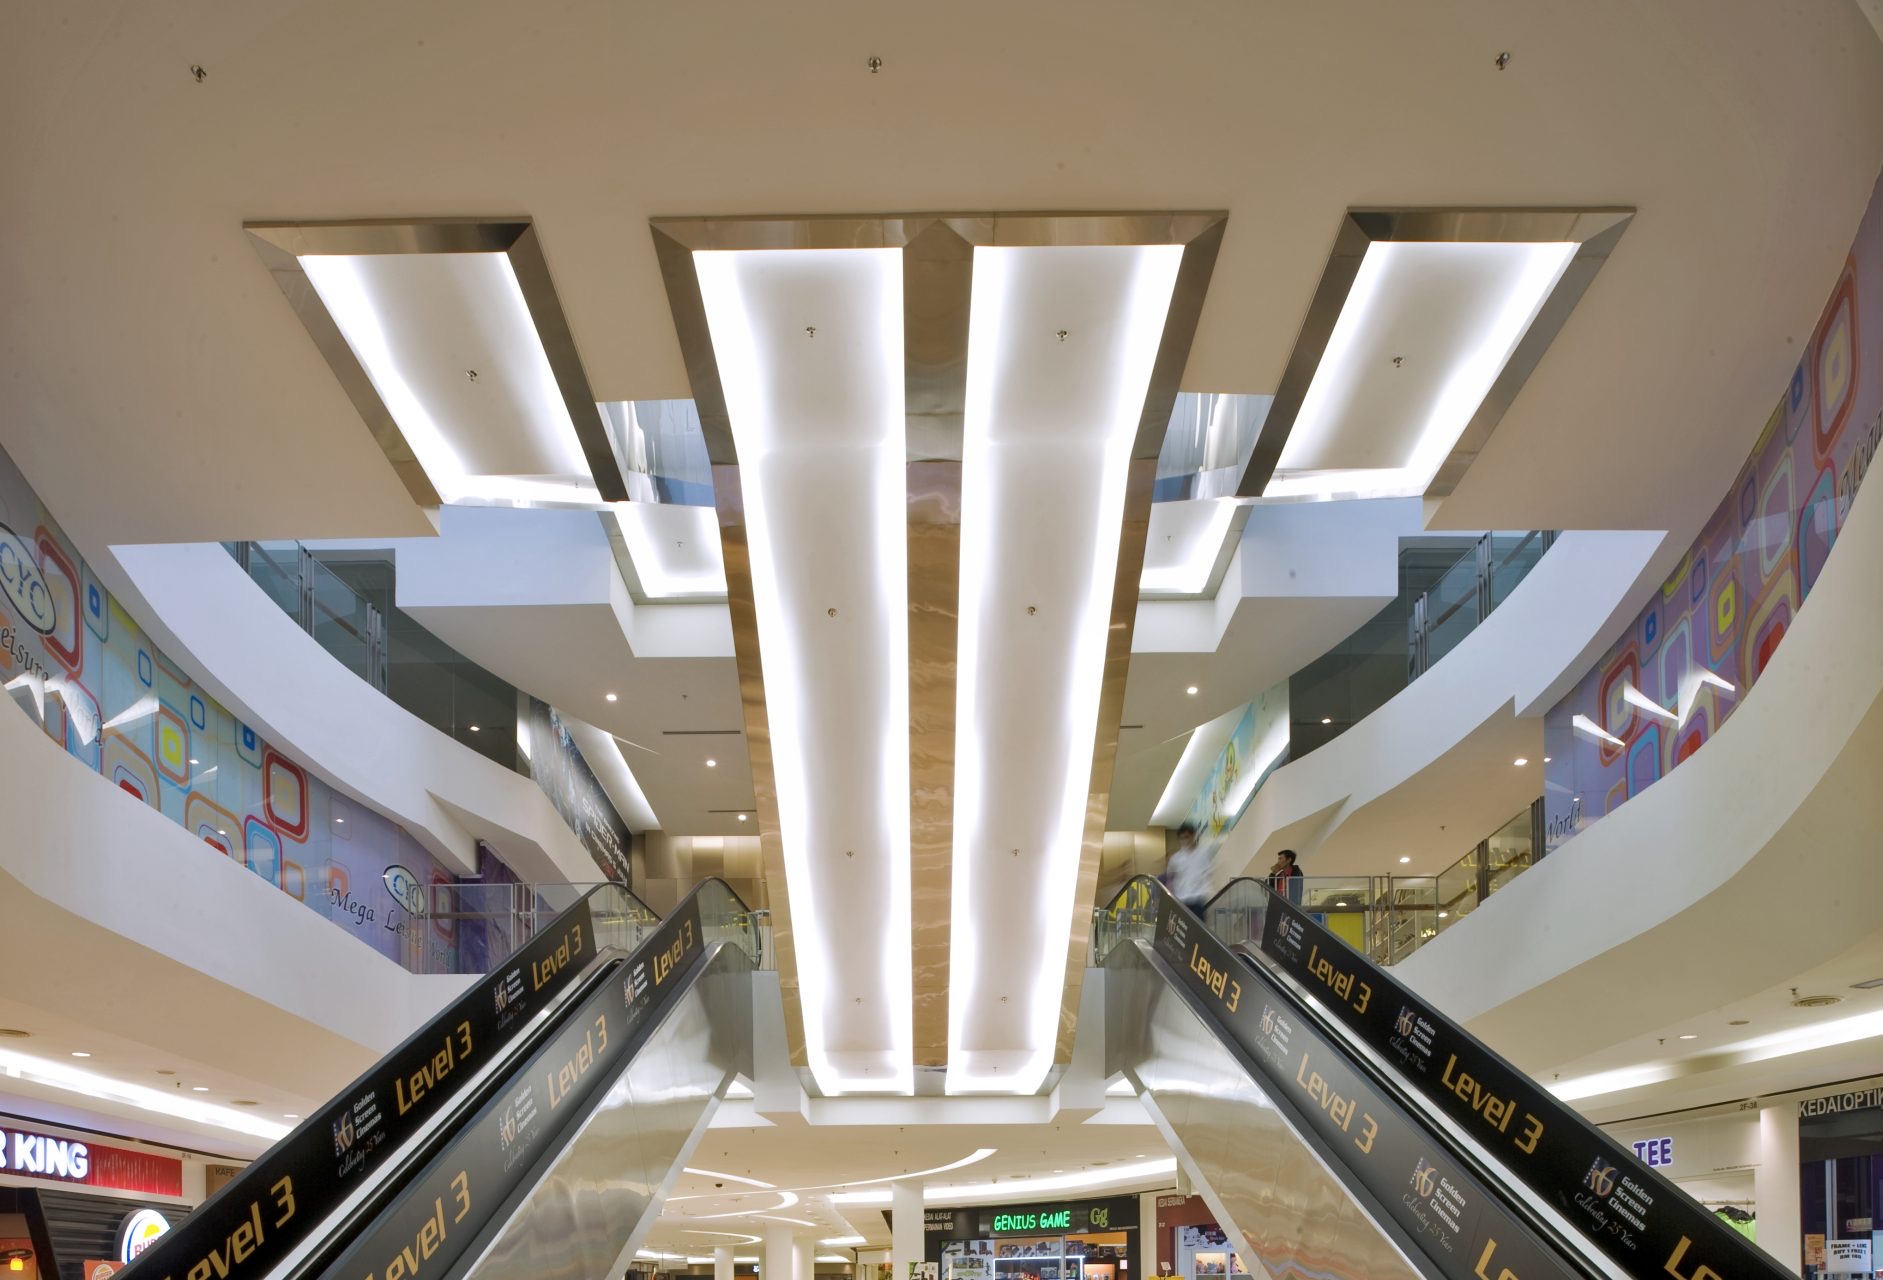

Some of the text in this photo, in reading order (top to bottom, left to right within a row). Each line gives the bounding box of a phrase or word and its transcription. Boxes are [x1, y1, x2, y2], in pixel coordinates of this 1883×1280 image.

[331, 888, 375, 925] Mega
[532, 924, 582, 992] Level 3
[653, 919, 694, 986] Level 3
[1190, 943, 1241, 1013] Level 3
[1307, 944, 1354, 1001] Level
[1353, 982, 1372, 1015] 3
[395, 1020, 474, 1116] Level 3
[546, 1014, 609, 1111] Level 3
[353, 1090, 376, 1114] Golden
[355, 1103, 377, 1127] Screen
[1296, 1053, 1378, 1155] Level 3
[1441, 1053, 1544, 1155] Level 3
[1799, 1096, 1841, 1117] KEDAI
[356, 1112, 382, 1140] Cinemas
[15, 1133, 88, 1179] KING
[1633, 1138, 1672, 1166] TEE
[271, 1175, 296, 1229] 3
[450, 1170, 471, 1225] 3
[1434, 1188, 1461, 1219] Screen
[1440, 1177, 1466, 1207] Golden
[1614, 1187, 1647, 1217] Screen
[1621, 1175, 1654, 1206] Golden
[994, 1210, 1070, 1231] GENIUS GAME
[1090, 1207, 1108, 1228] Gg
[1429, 1199, 1461, 1233] Cinemas
[1574, 1192, 1637, 1251] Celebrating 25 Years
[1608, 1196, 1647, 1232] Cinemas
